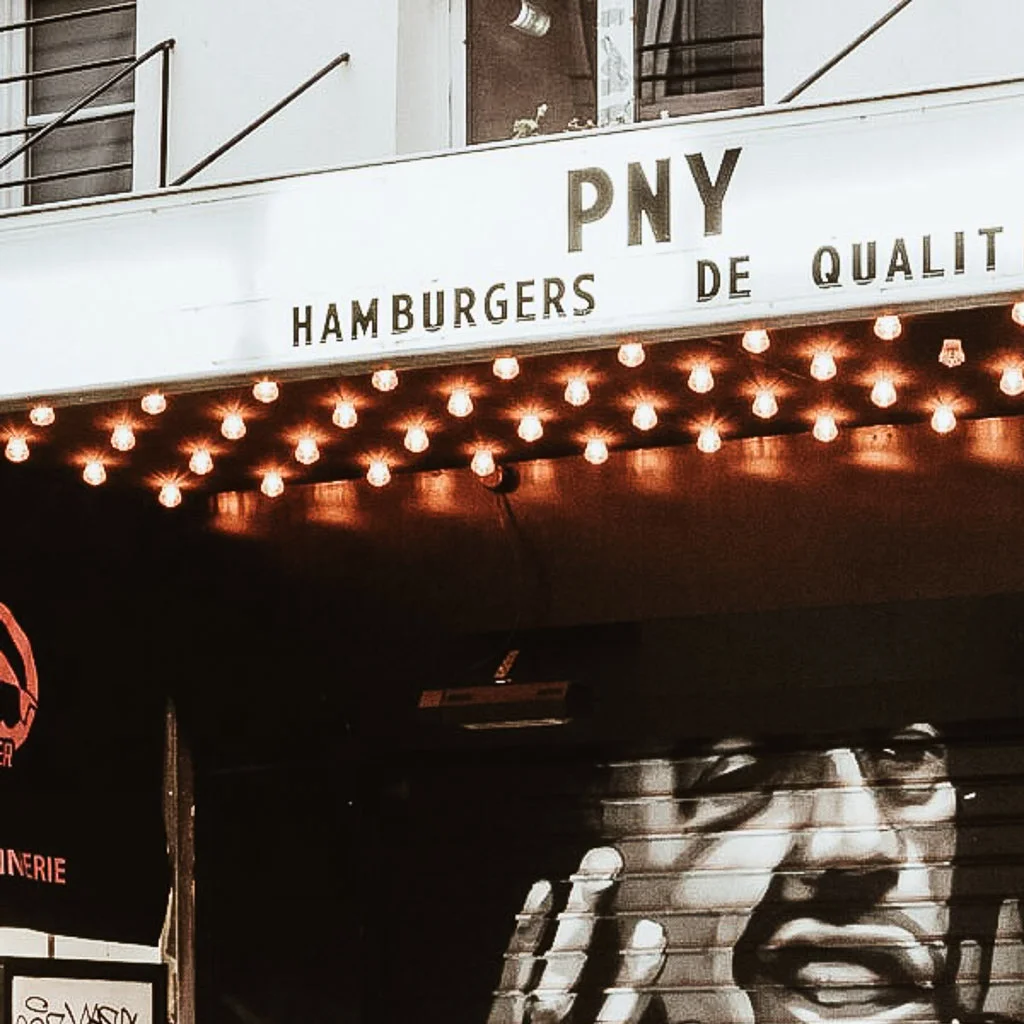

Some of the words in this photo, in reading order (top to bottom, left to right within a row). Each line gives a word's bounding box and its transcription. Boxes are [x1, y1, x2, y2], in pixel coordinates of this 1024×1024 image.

[567, 147, 742, 253] PNY
[292, 273, 596, 347] HAMBURGERS
[696, 255, 752, 303] DE
